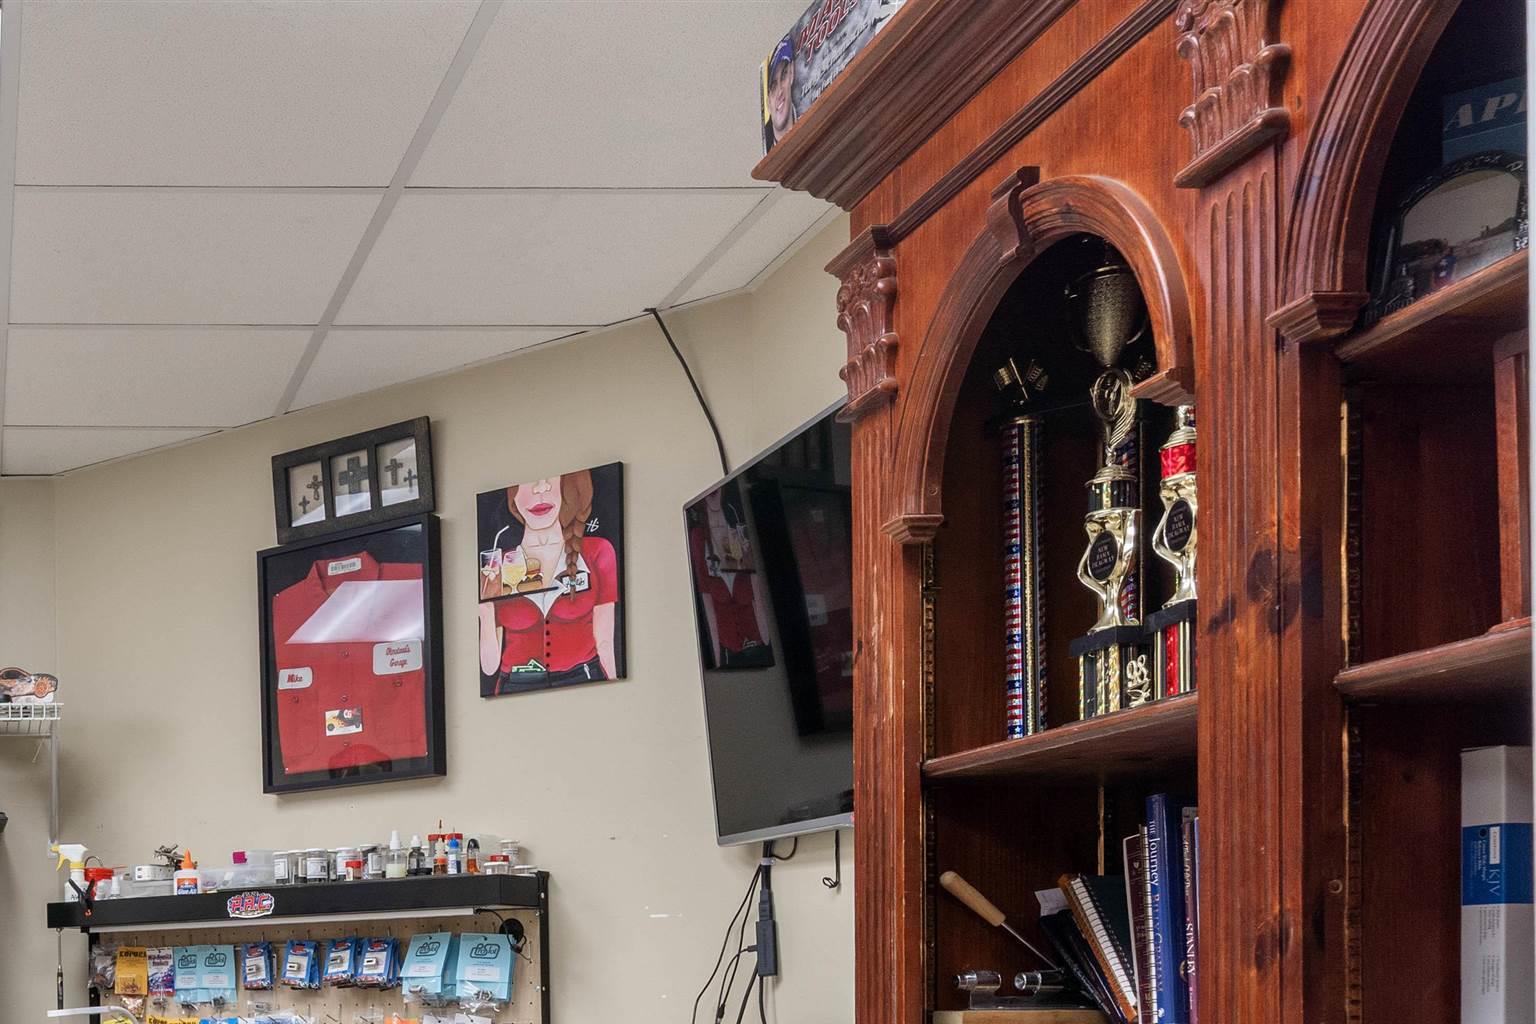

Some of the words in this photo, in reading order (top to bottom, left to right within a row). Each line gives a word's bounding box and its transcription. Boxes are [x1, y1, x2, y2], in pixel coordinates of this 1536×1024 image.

[287, 674, 303, 683] Mike
[1149, 838, 1160, 886] Journey
[1488, 869, 1500, 896] KJV
